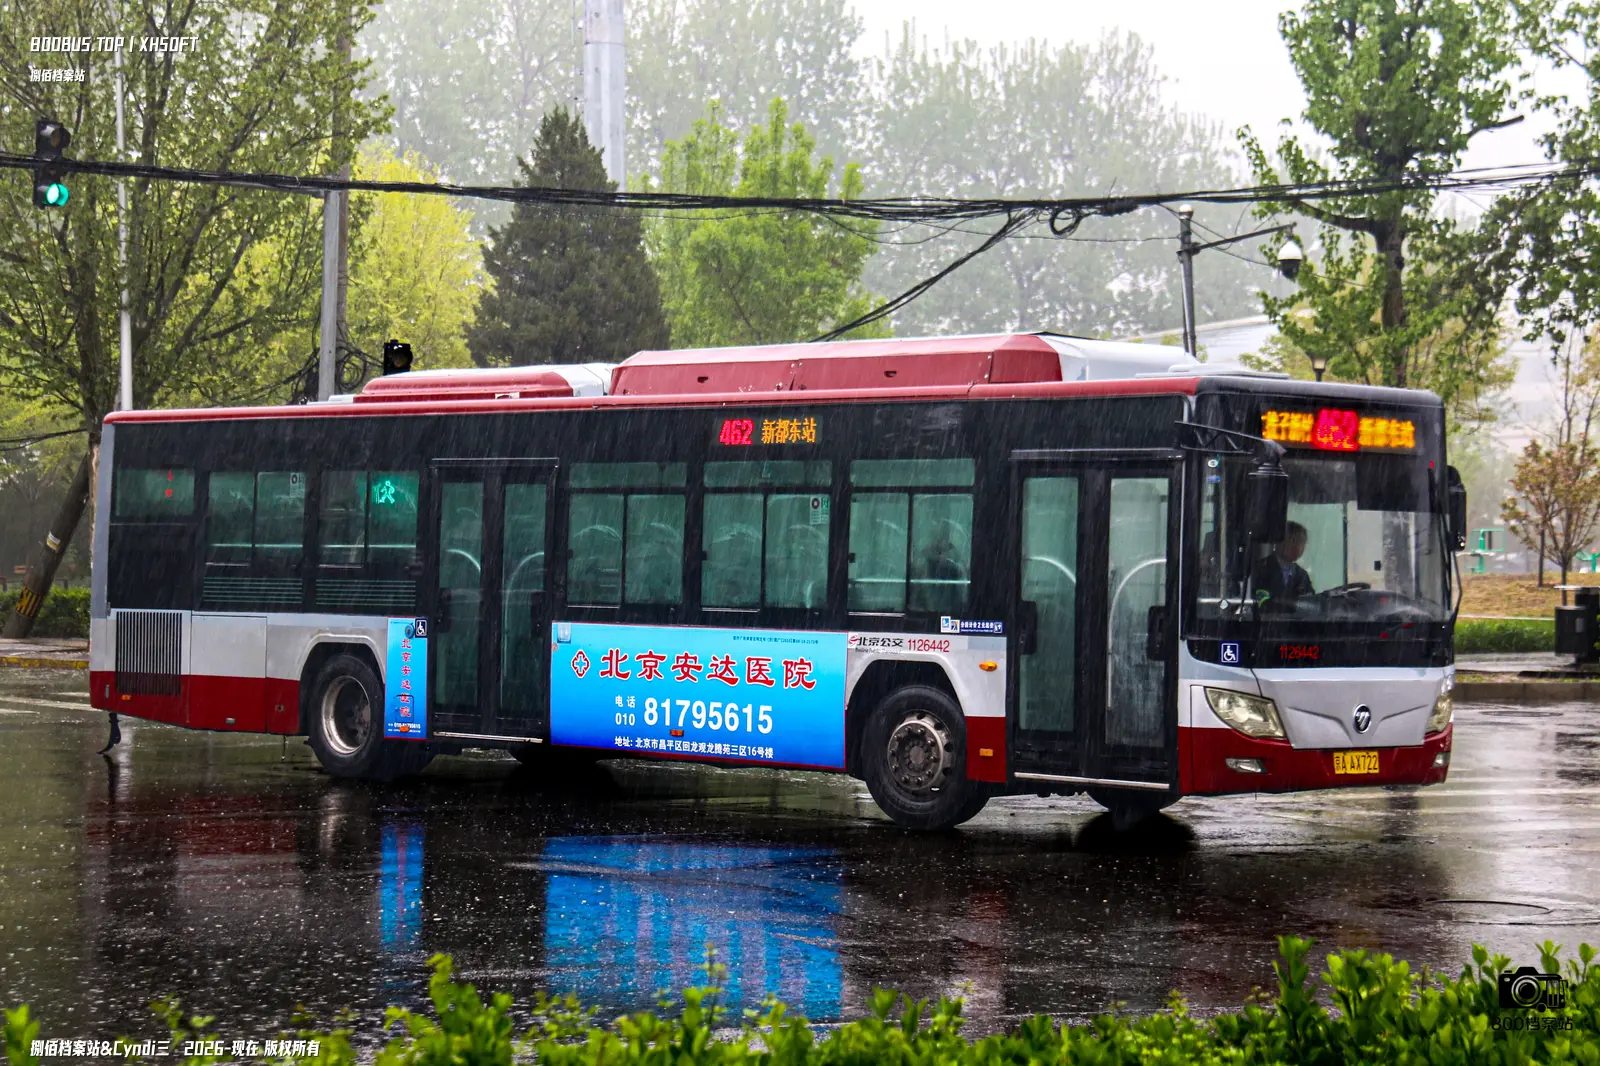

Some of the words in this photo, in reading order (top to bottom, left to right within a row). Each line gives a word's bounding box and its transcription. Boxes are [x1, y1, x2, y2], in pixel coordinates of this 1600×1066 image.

[719, 418, 754, 446] 462
[761, 416, 817, 444] 新都东站
[856, 636, 904, 648] 北京公交
[907, 638, 950, 653] 1126442
[1279, 644, 1320, 660] 1126442
[600, 648, 817, 691] 北京安达医院
[615, 694, 636, 709] 电话
[615, 712, 636, 726] 010
[643, 697, 773, 735] 81795615
